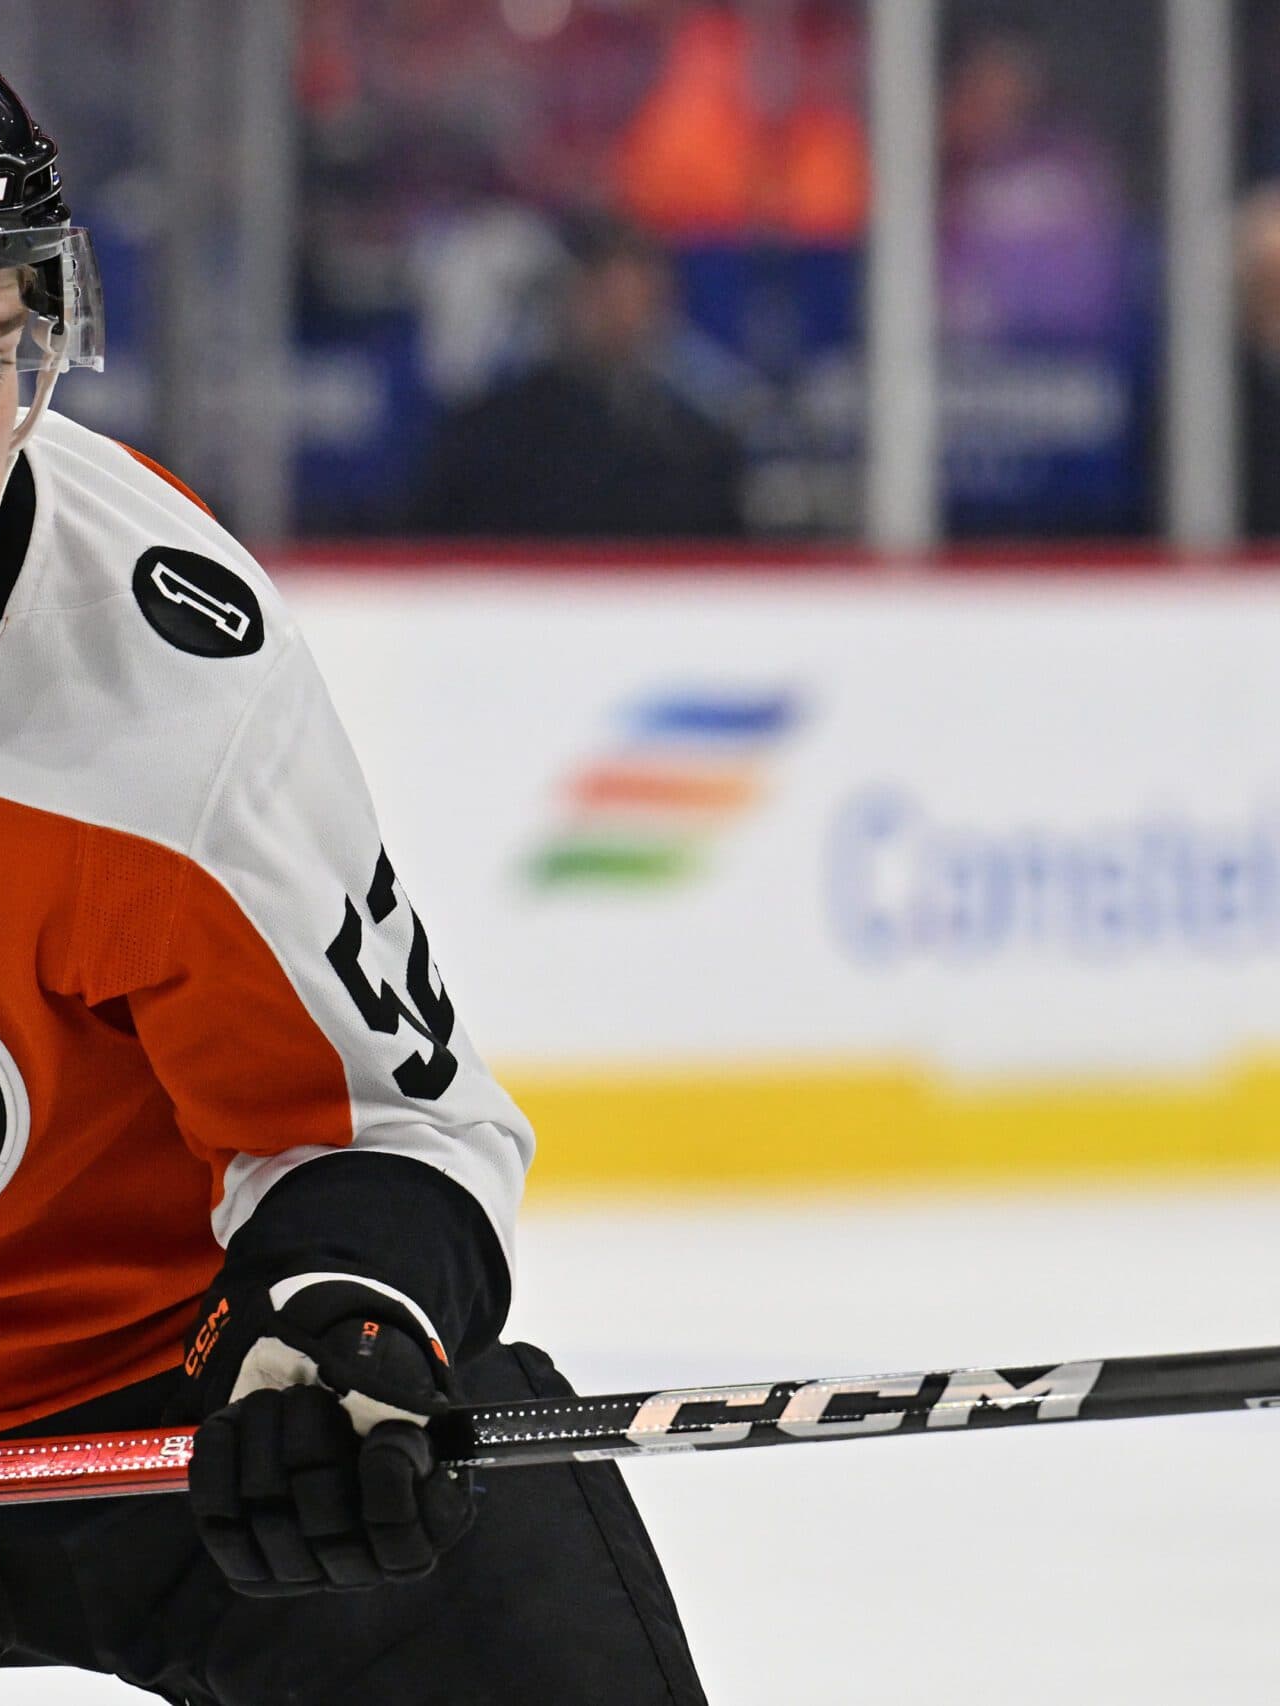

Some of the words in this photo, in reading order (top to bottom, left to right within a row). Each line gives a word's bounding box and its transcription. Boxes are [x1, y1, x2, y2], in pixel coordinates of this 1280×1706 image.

[150, 560, 251, 641] 1
[185, 1297, 229, 1377] CCM
[624, 1360, 1105, 1444] CCM
